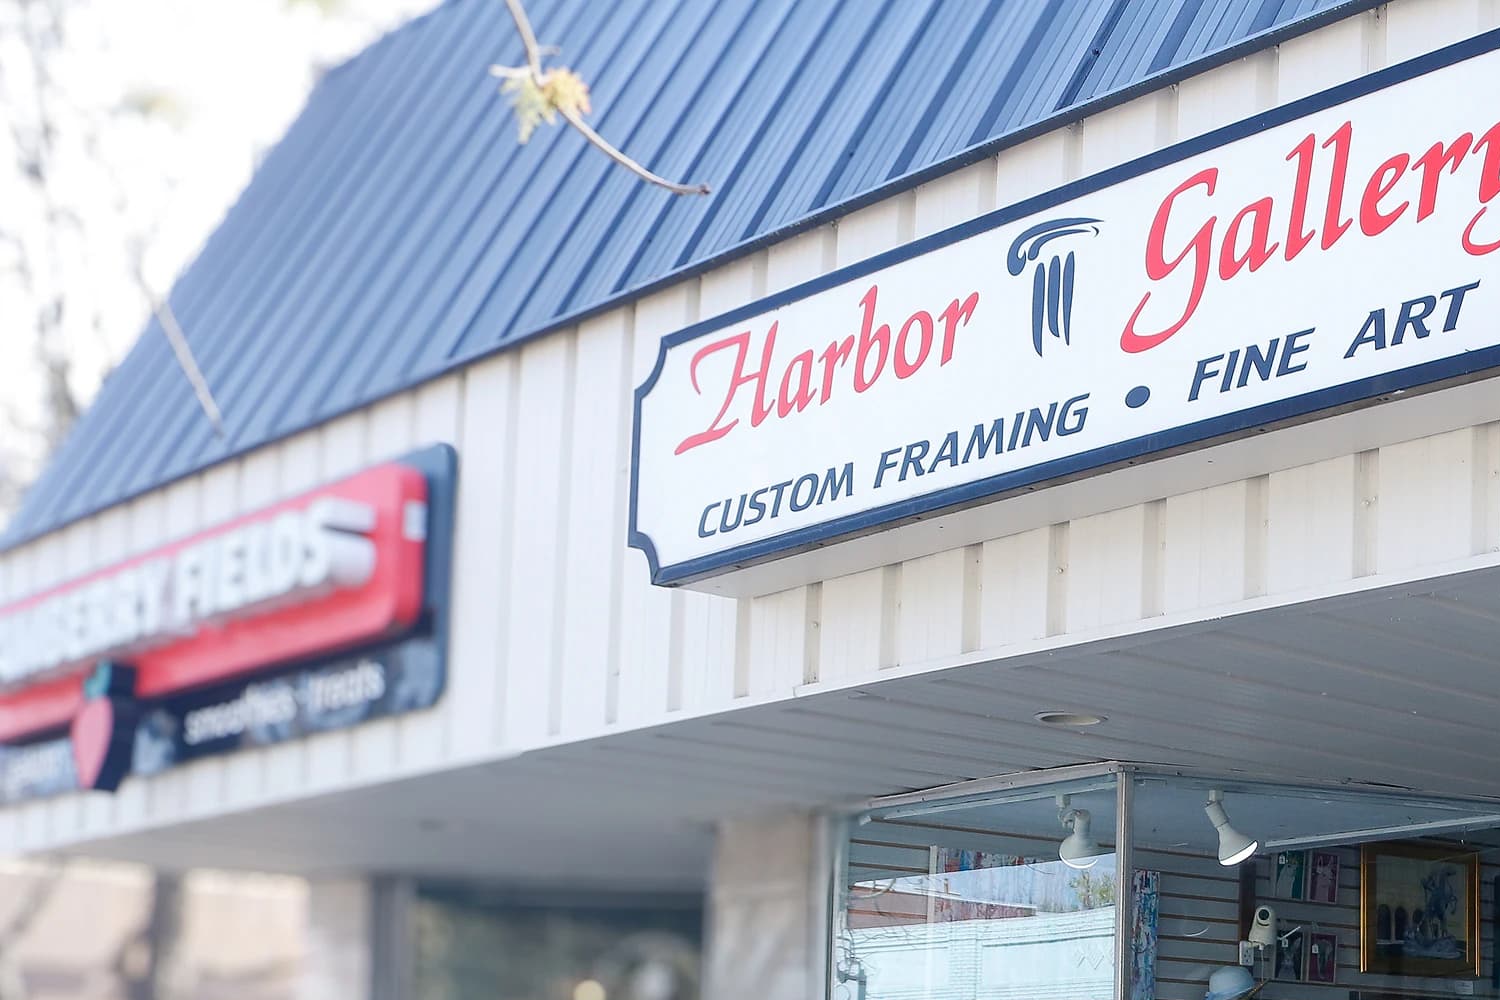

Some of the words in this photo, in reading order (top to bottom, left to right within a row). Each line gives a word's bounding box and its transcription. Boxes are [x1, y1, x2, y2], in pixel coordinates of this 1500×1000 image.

[674, 284, 979, 456] Harbor
[698, 462, 854, 538] CUSTOM
[873, 392, 1091, 488] FRAMING
[1188, 327, 1316, 402] FINE
[1343, 279, 1481, 359] ART
[175, 498, 355, 622] FIELDS
